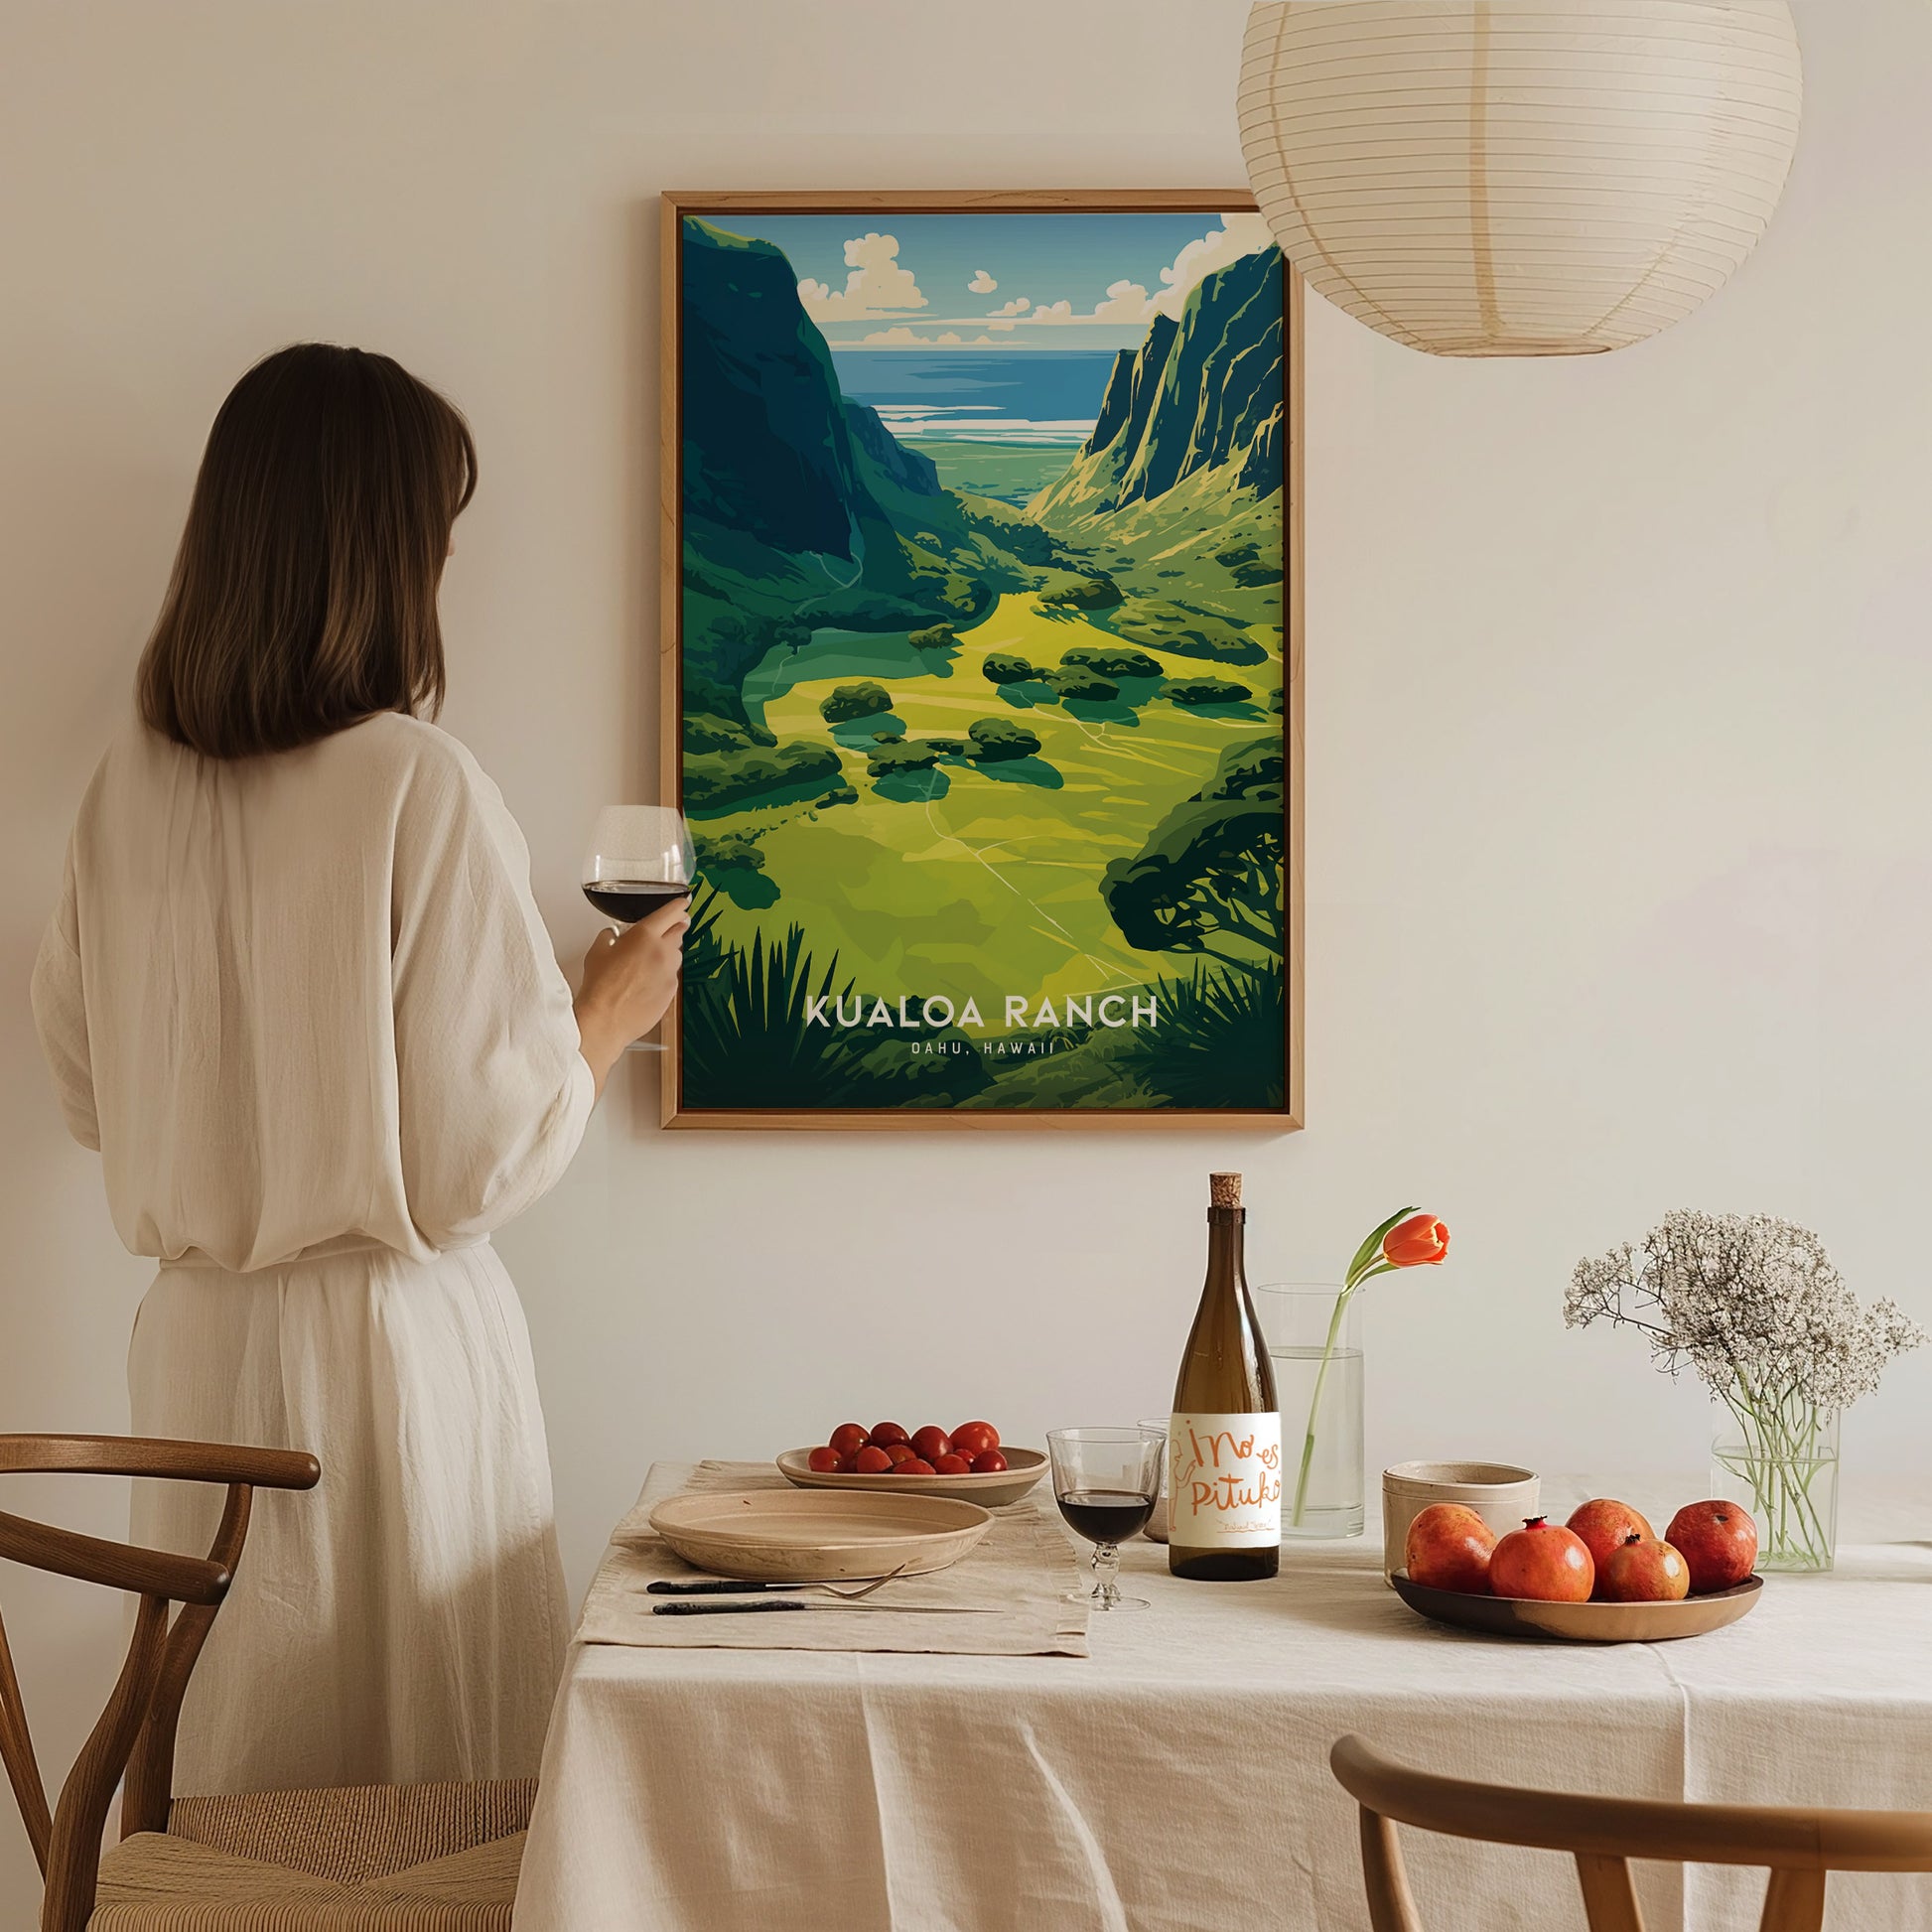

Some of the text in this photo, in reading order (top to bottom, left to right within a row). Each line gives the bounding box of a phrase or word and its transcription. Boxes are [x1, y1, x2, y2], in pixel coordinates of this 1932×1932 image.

[806, 995, 1158, 1028] KUALOA RANCH
[911, 1042, 1054, 1055] OAHU, HAWAII
[1256, 1444, 1279, 1469] es
